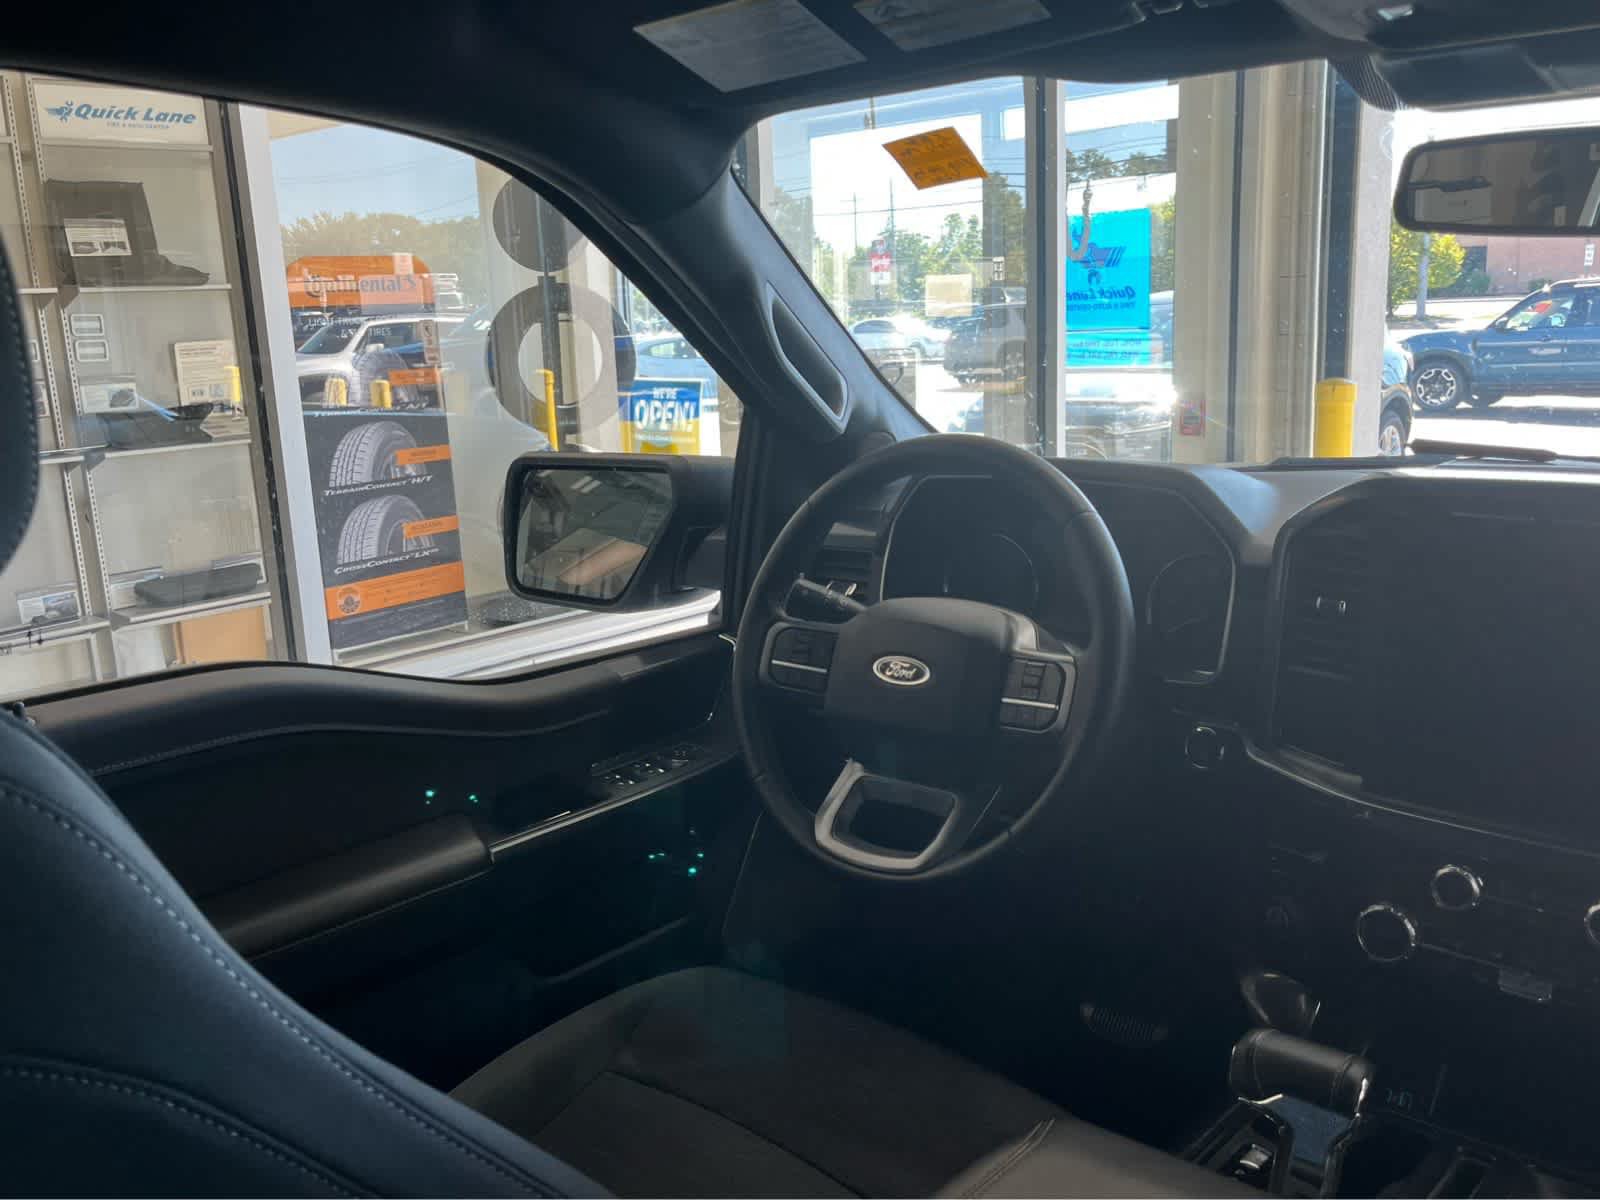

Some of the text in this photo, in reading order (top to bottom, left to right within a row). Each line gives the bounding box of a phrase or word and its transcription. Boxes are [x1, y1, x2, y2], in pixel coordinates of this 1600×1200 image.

[74, 104, 196, 124] Quick Lane
[634, 400, 697, 432] OPEN!
[885, 660, 917, 679] Ford
